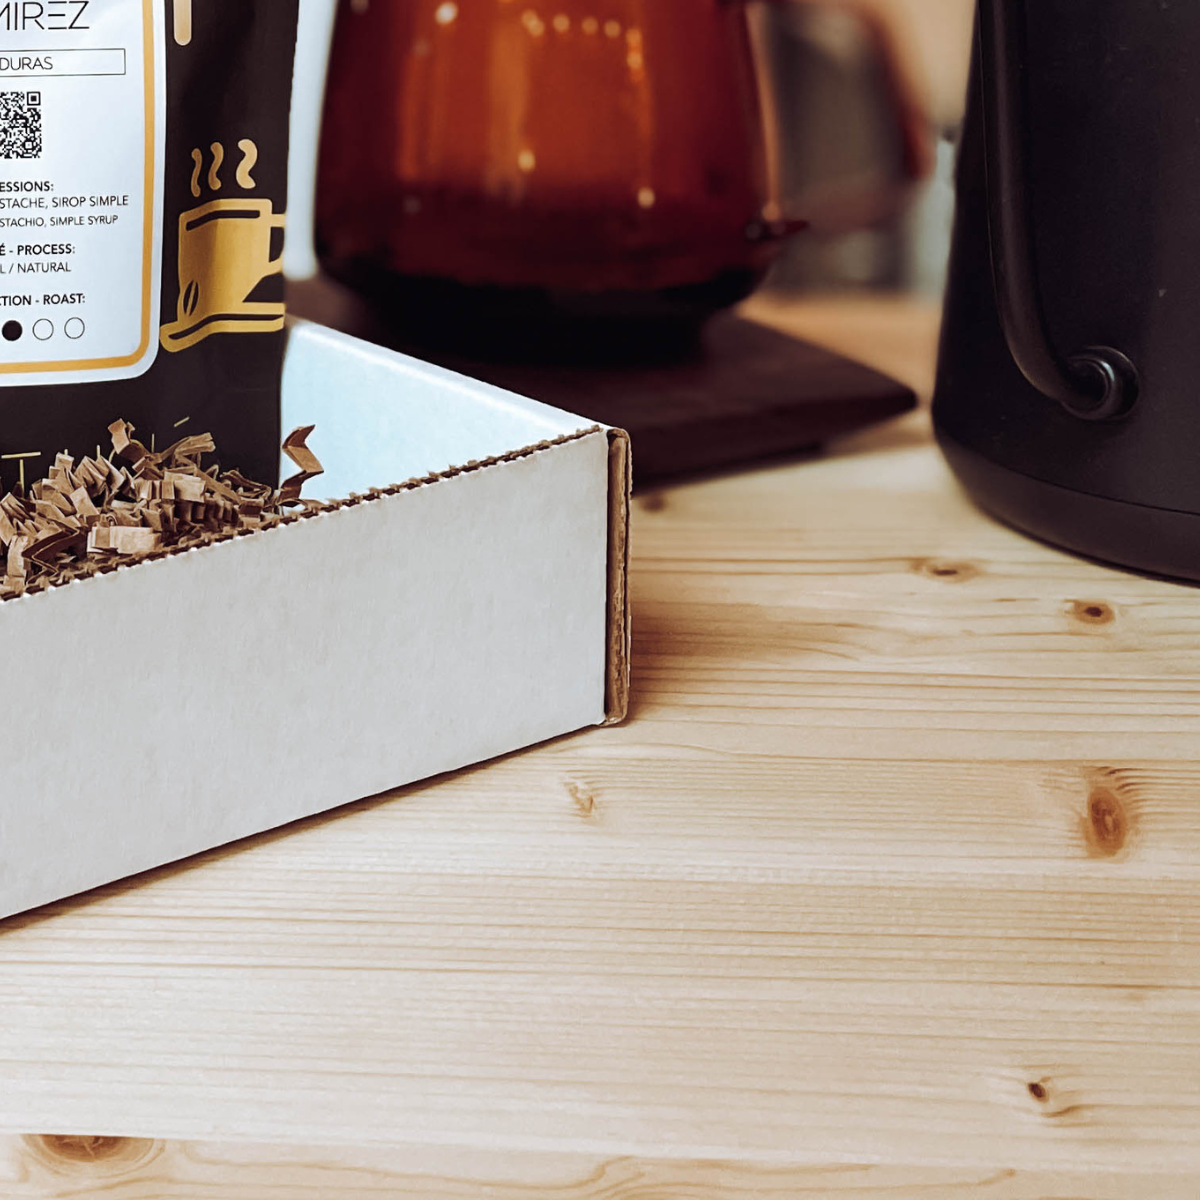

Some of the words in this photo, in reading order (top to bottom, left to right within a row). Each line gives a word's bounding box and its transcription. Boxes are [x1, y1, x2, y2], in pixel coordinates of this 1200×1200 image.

[52, 196, 86, 208] SIROP
[89, 195, 129, 207] SIMPLE
[50, 216, 85, 227] SIMPLE
[87, 215, 118, 225] SYRUP
[17, 243, 75, 255] PROCESS:
[17, 262, 71, 273] NATURAL
[43, 293, 85, 305] ROAST:
